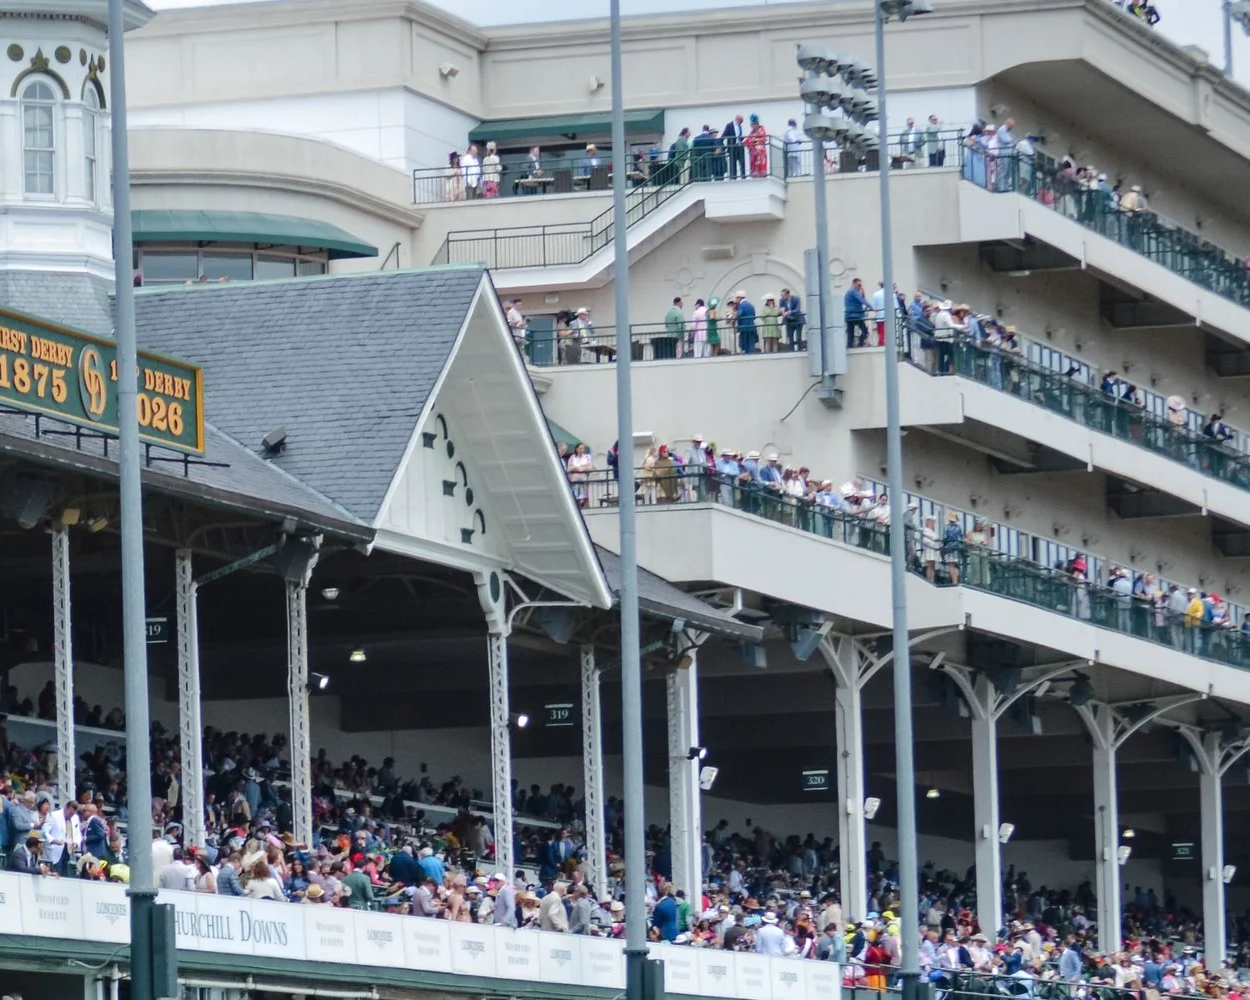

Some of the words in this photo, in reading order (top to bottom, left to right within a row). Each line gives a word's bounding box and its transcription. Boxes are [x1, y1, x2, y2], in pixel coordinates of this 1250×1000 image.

[30, 335, 74, 369] DERBY
[144, 368, 191, 401] DERBY
[137, 393, 184, 436] 026
[150, 624, 161, 636] 19
[550, 709, 569, 720] 319
[807, 776, 825, 785] 320
[174, 911, 234, 940] HURCHILL
[239, 910, 288, 946] DOWNS
